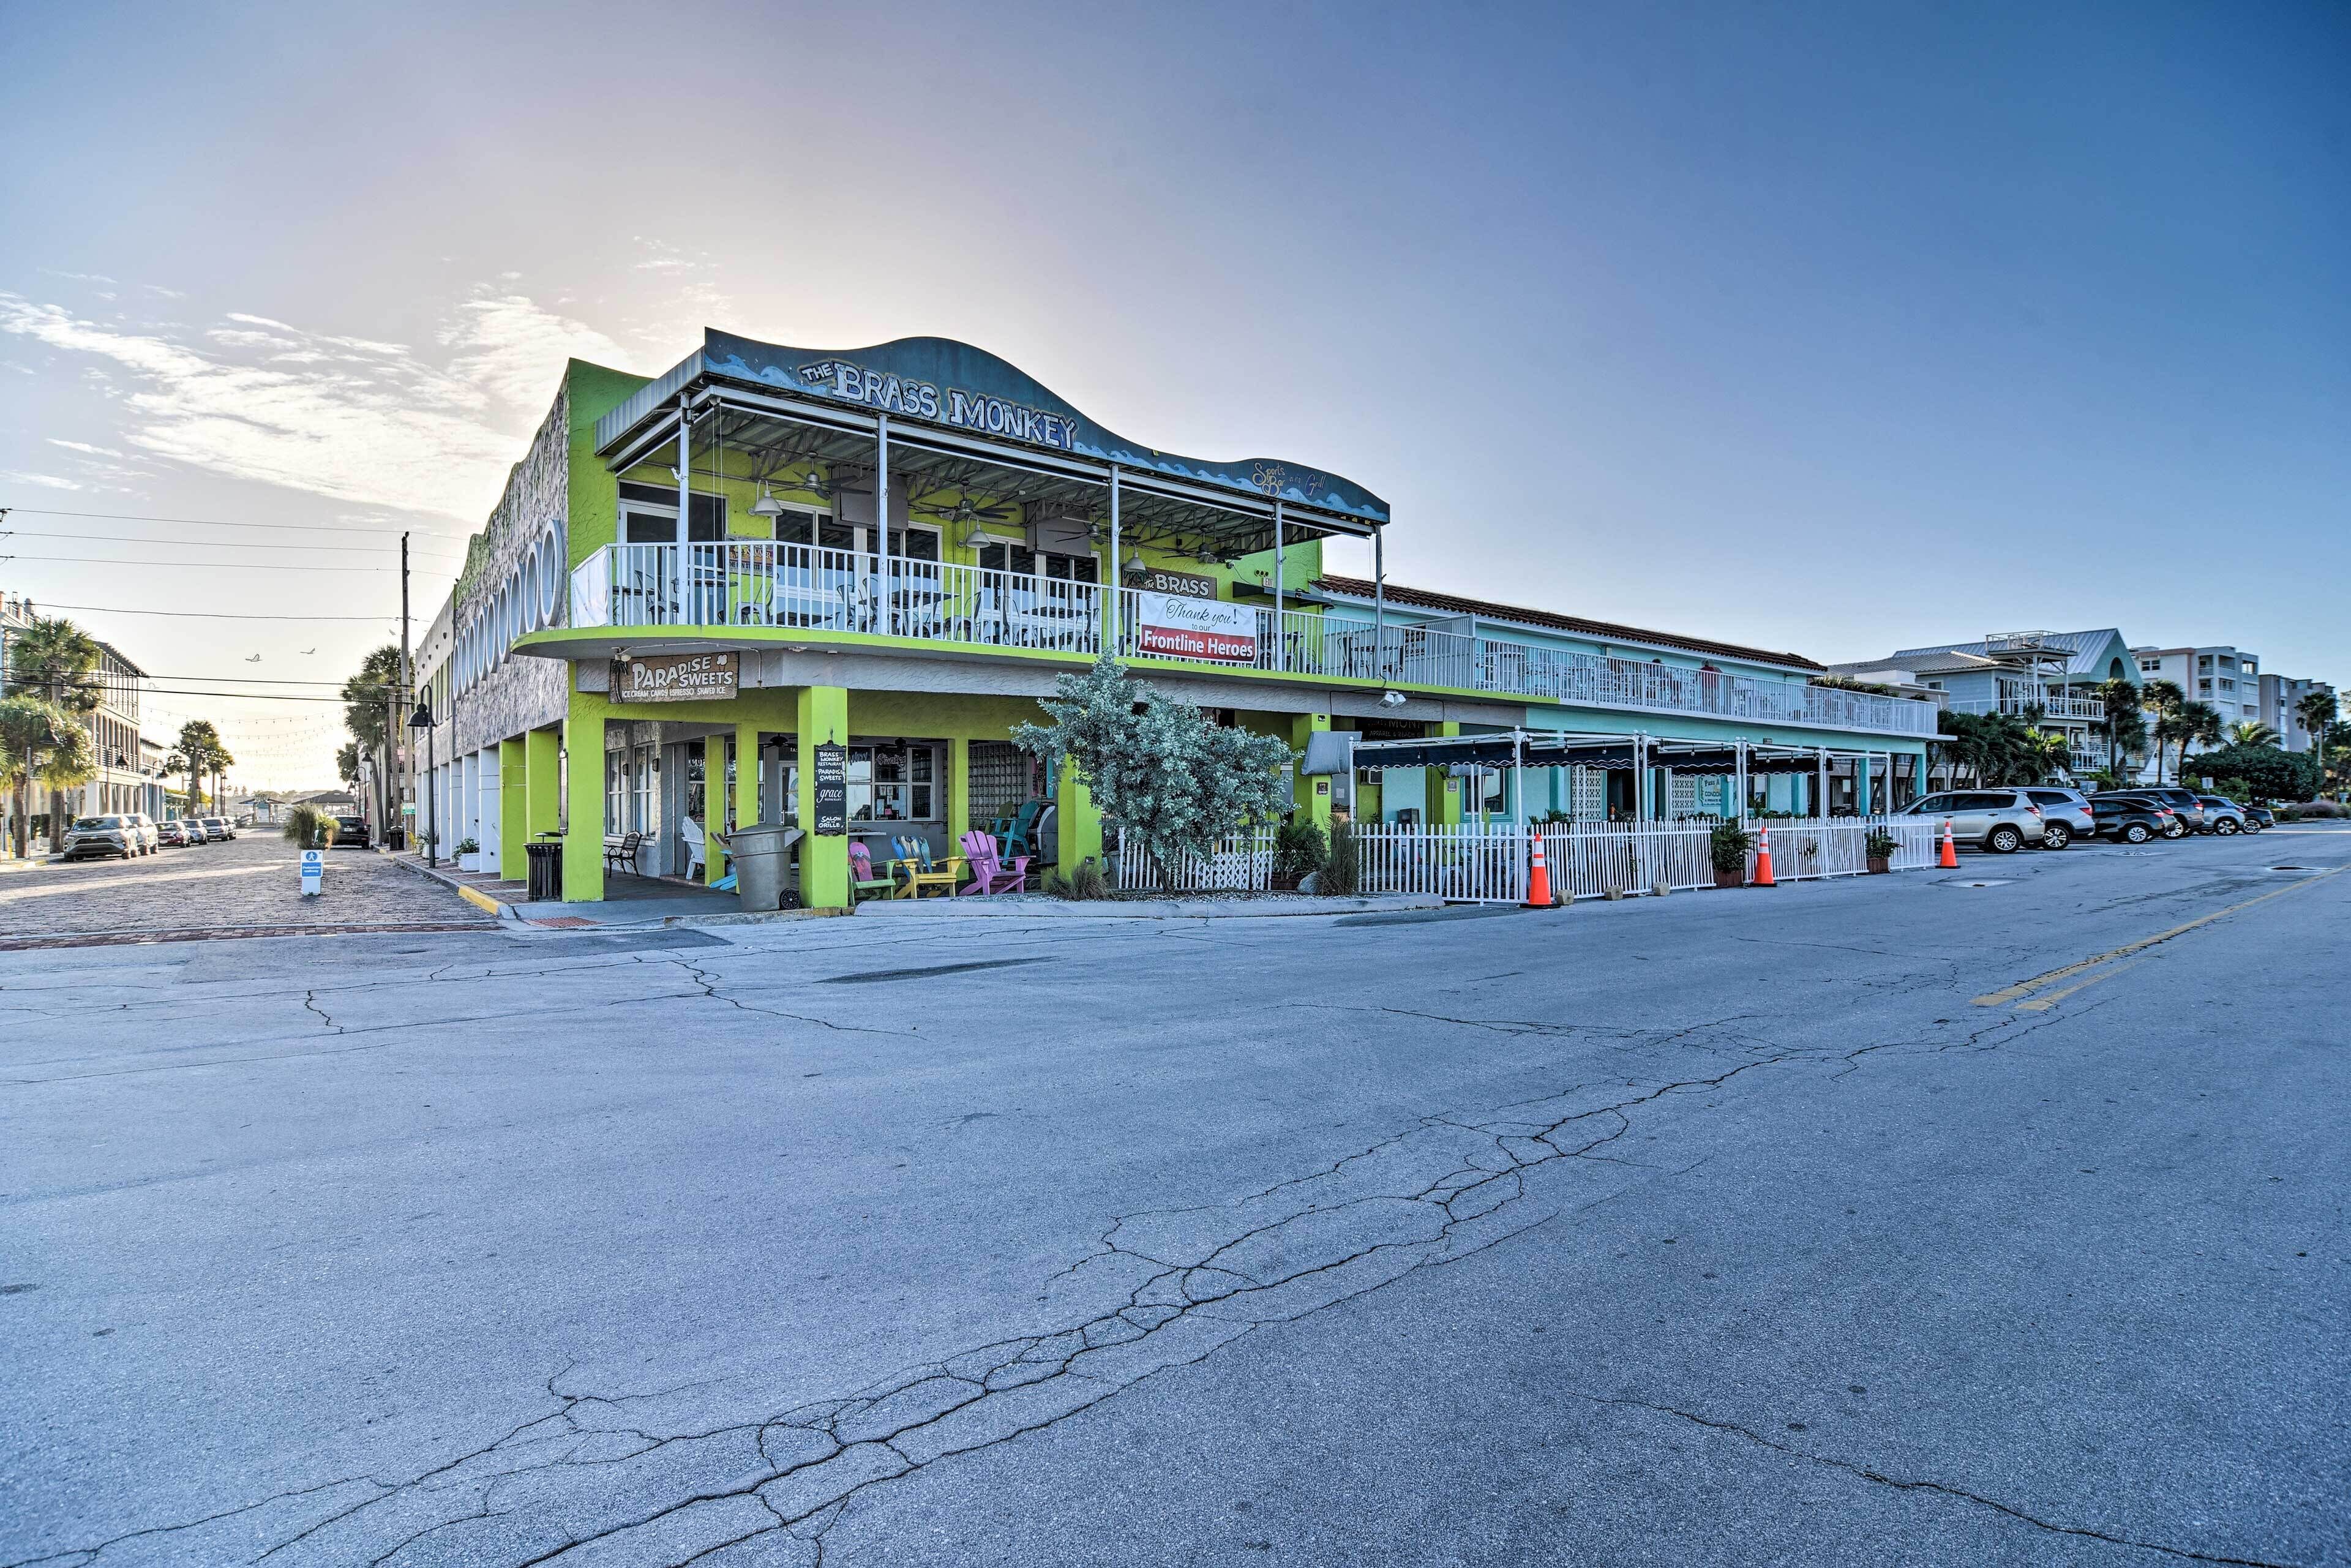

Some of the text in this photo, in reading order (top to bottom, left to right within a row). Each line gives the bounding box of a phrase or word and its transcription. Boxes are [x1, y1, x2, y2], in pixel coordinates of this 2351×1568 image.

[801, 362, 1076, 450] THE BRASS MONKEY
[1252, 462, 1285, 486] Sports
[1262, 476, 1285, 497] Bar
[1305, 474, 1327, 496] Grill
[1144, 577, 1154, 590] the
[1155, 574, 1210, 596] BRASS
[1166, 598, 1210, 621] Thank
[1144, 631, 1253, 658] Frontline Heroes
[632, 656, 711, 689] PARADISE
[678, 671, 733, 687] SWEETS
[816, 789, 843, 803] grace
